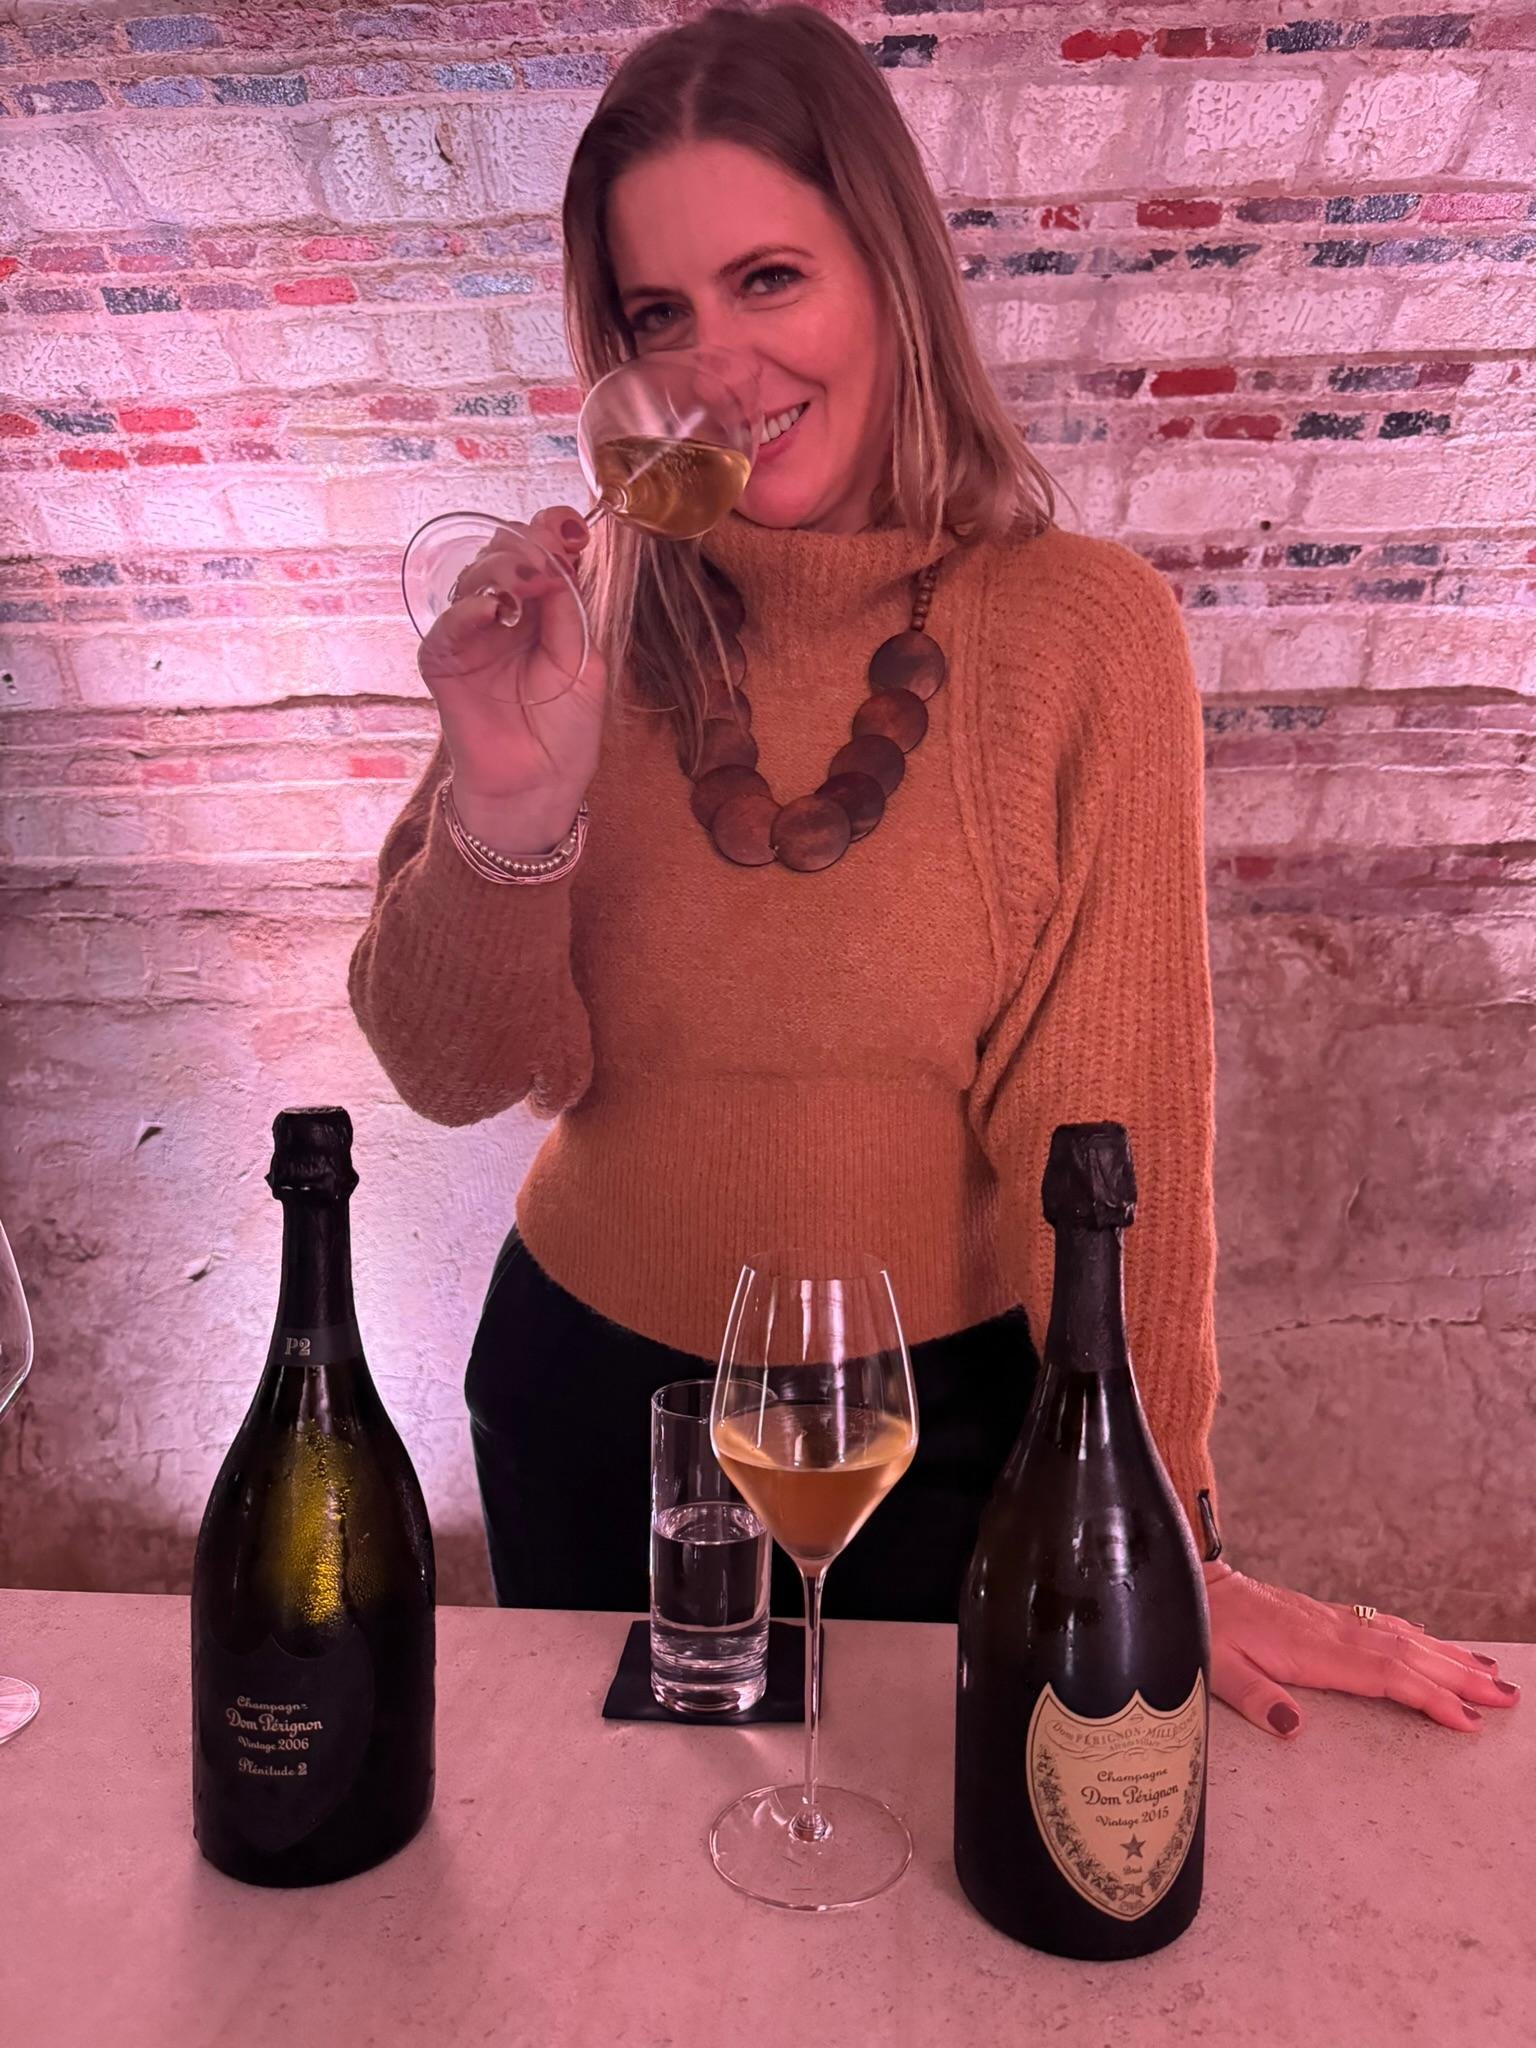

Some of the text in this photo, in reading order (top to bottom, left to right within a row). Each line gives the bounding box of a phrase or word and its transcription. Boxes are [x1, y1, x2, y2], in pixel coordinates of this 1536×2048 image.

[284, 1336, 311, 1356] P2
[237, 1695, 309, 1715] Champagne
[225, 1707, 323, 1738] Dom Pérignon
[238, 1735, 310, 1753] Vintage 2006
[297, 1762, 308, 1776] 2
[1097, 1768, 1169, 1783] Champagne
[1080, 1784, 1180, 1807] Dom Pérignon
[1095, 1805, 1170, 1830] Vintage 2015
